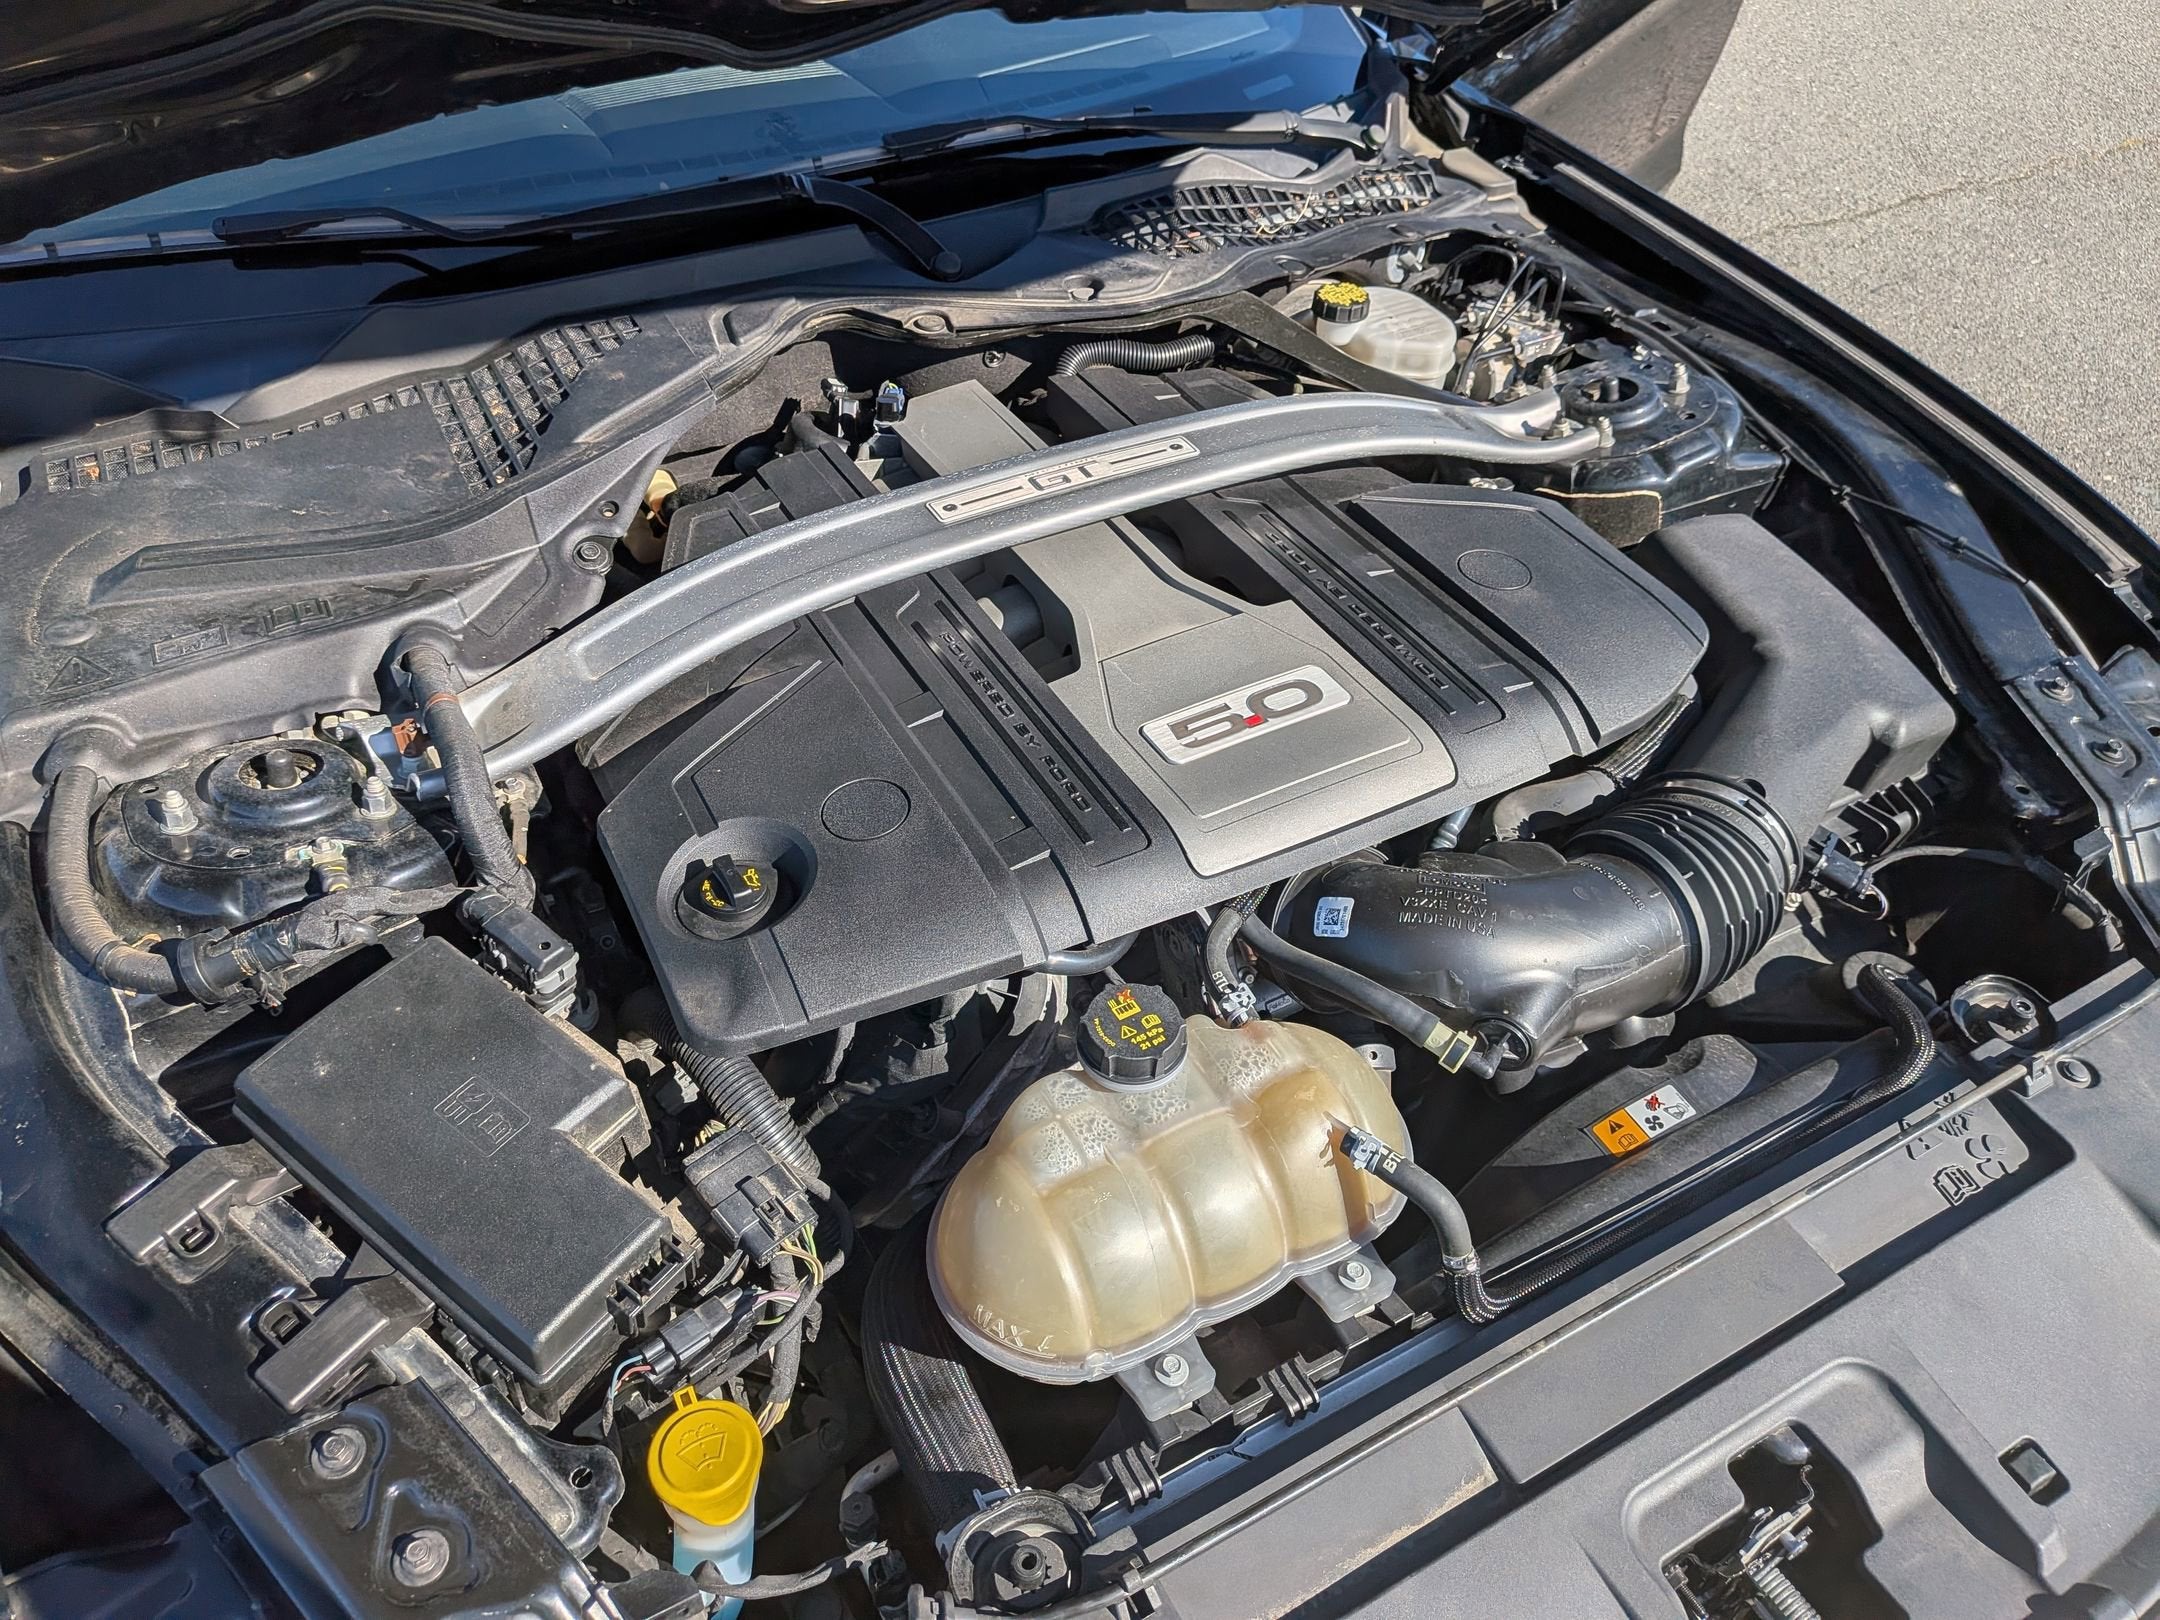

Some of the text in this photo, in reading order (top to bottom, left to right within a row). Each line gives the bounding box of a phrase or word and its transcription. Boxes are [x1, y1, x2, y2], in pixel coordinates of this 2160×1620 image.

[1027, 460, 1100, 492] GT
[1264, 532, 1449, 690] POWERED BY FORD
[938, 631, 1093, 813] POWERED BY FORD
[1166, 679, 1324, 749] 5.0
[1398, 912, 1497, 940] MADE IN USA
[1130, 1027, 1165, 1045] 145 kPa
[1139, 1039, 1152, 1051] 21
[973, 1303, 1031, 1348] MAX
